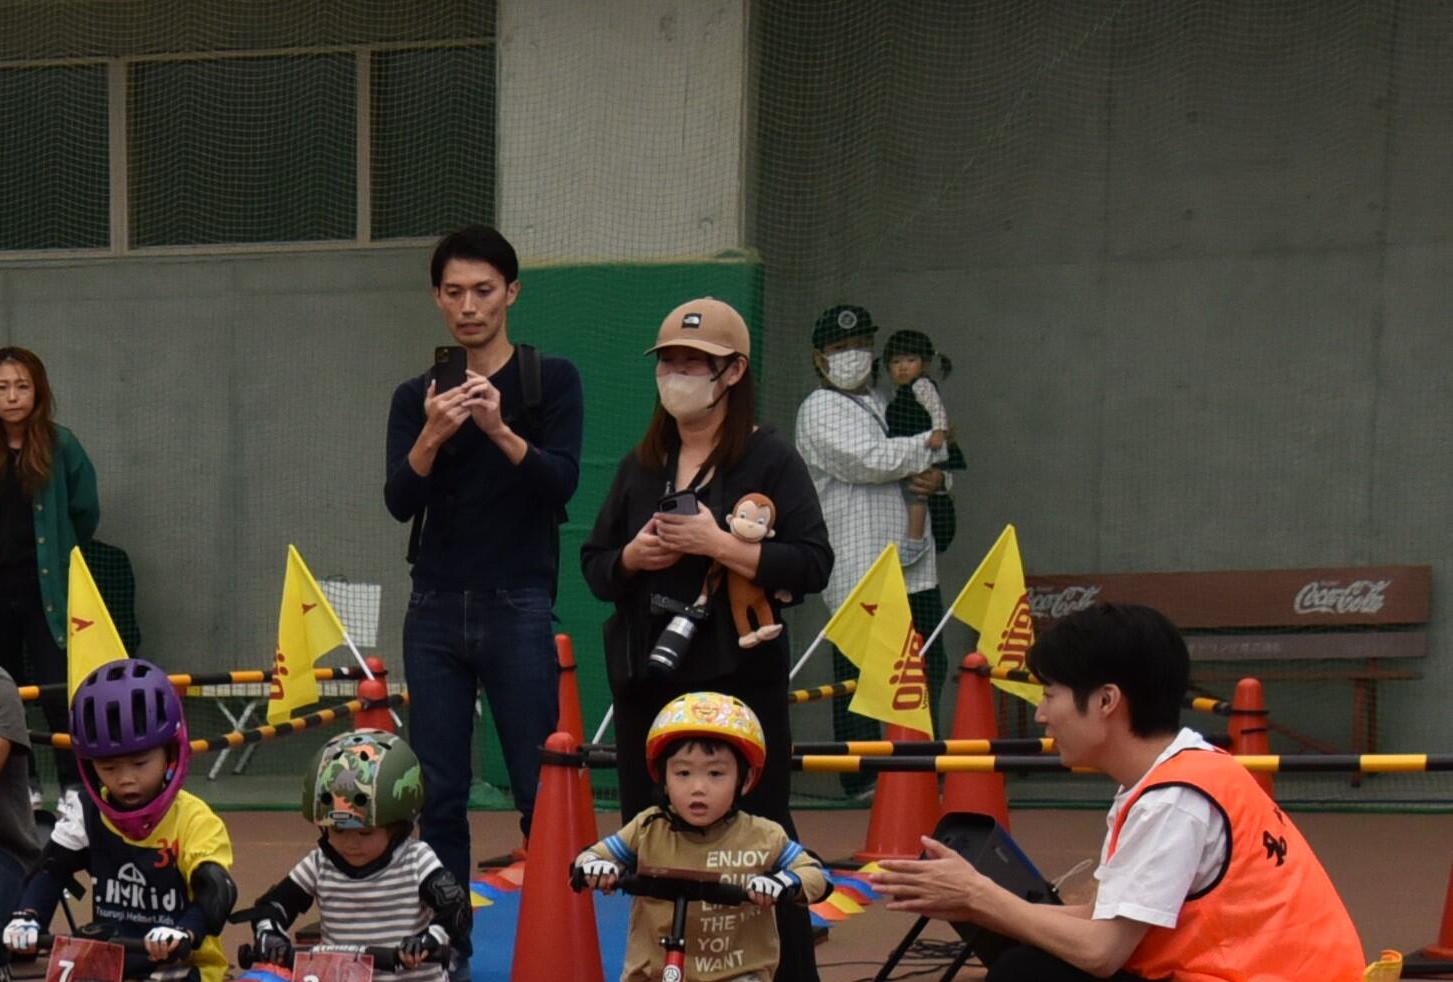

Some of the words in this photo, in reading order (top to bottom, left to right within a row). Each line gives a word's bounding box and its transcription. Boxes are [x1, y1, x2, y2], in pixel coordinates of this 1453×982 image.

[1293, 580, 1392, 615] Coca-Cola
[706, 850, 770, 868] ENJOY
[700, 915, 736, 932] THE
[694, 950, 744, 972] WANT
